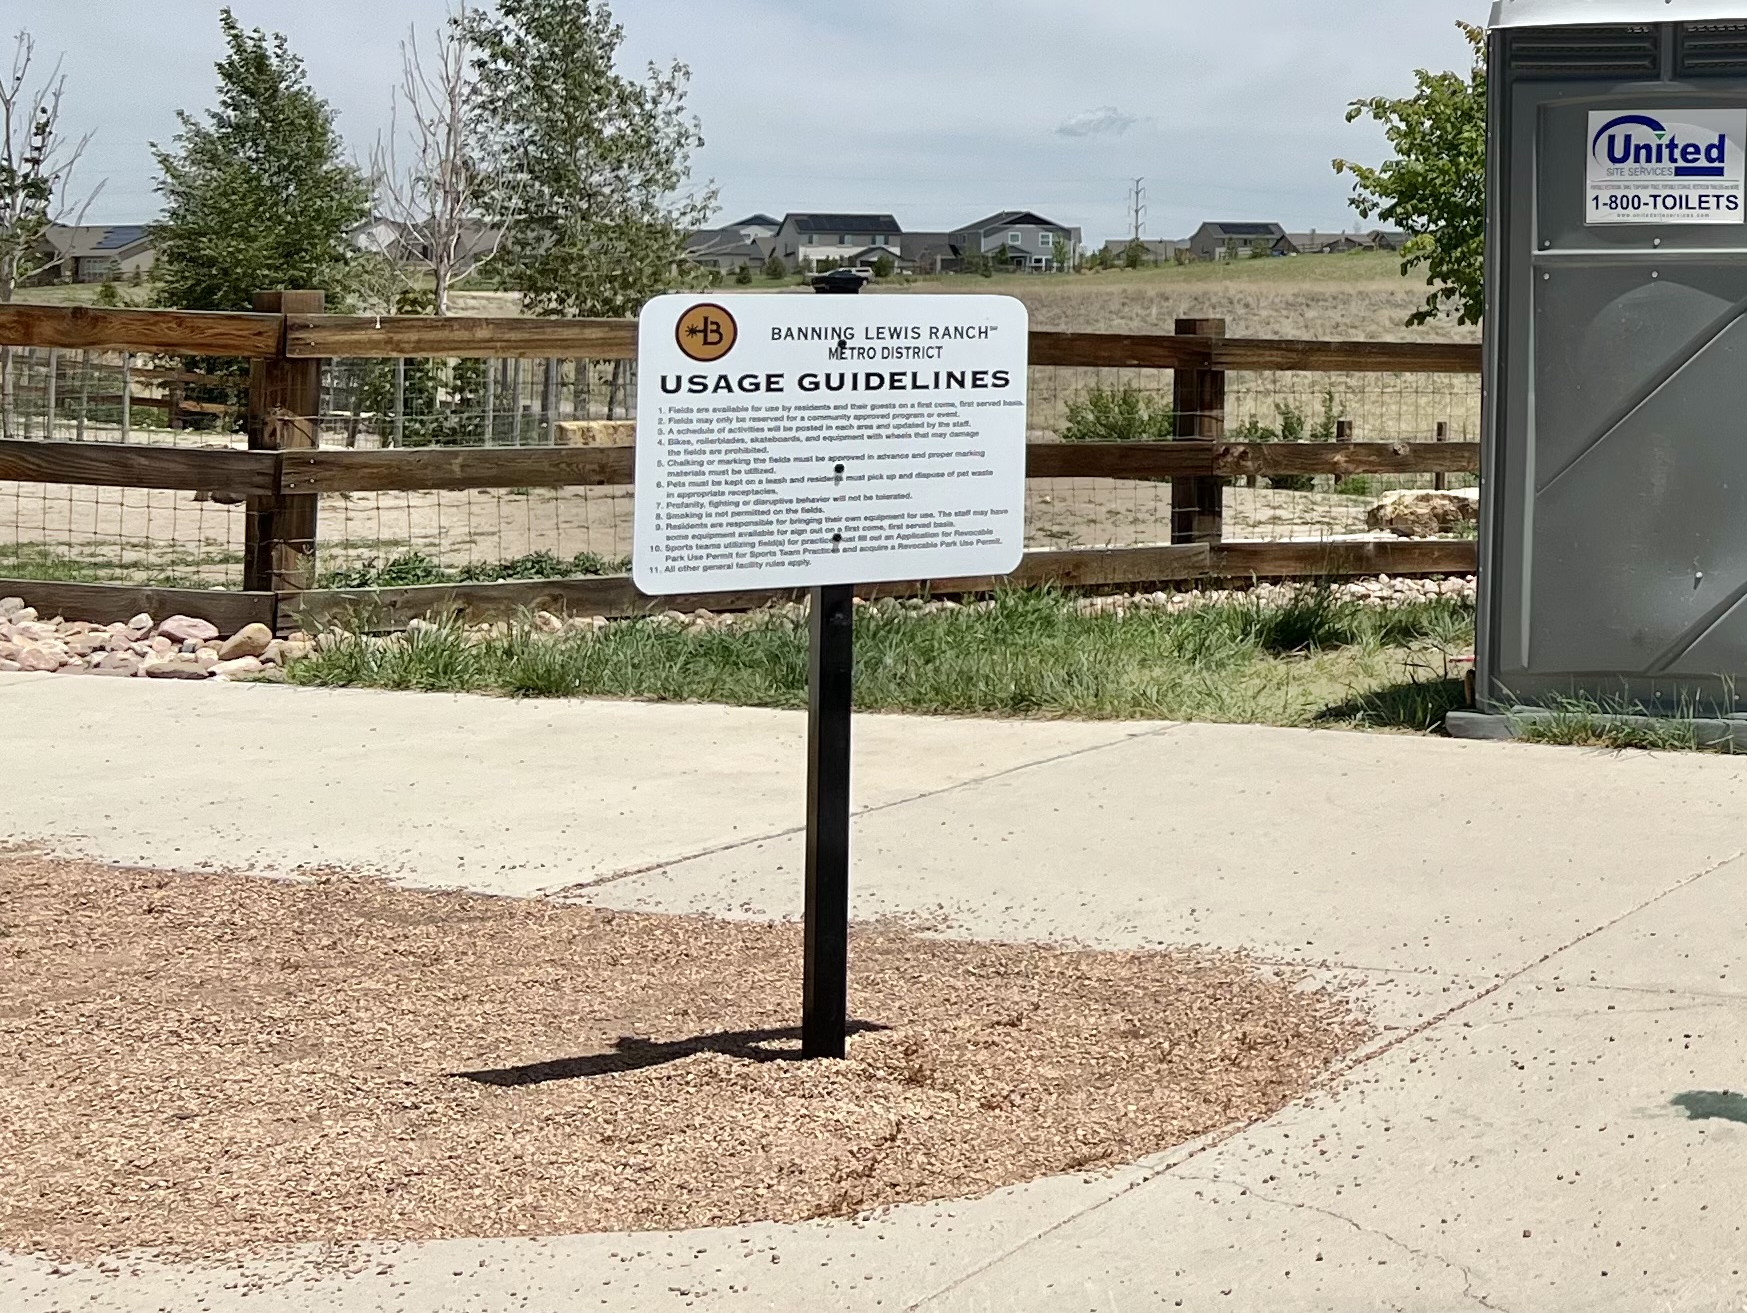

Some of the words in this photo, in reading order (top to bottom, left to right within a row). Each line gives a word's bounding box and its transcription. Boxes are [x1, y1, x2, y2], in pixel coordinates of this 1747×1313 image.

[1607, 134, 1726, 164] United
[1606, 167, 1626, 177] SITE
[1627, 167, 1674, 177] SERVICES
[1591, 194, 1739, 211] 1-800-TOILETS
[771, 326, 855, 341] BANNING
[865, 326, 921, 340] LEWIS
[828, 346, 877, 361] METRO
[881, 345, 943, 360] DISTRICT
[660, 373, 785, 394] USAGE
[797, 369, 1010, 392] GUIDELINES
